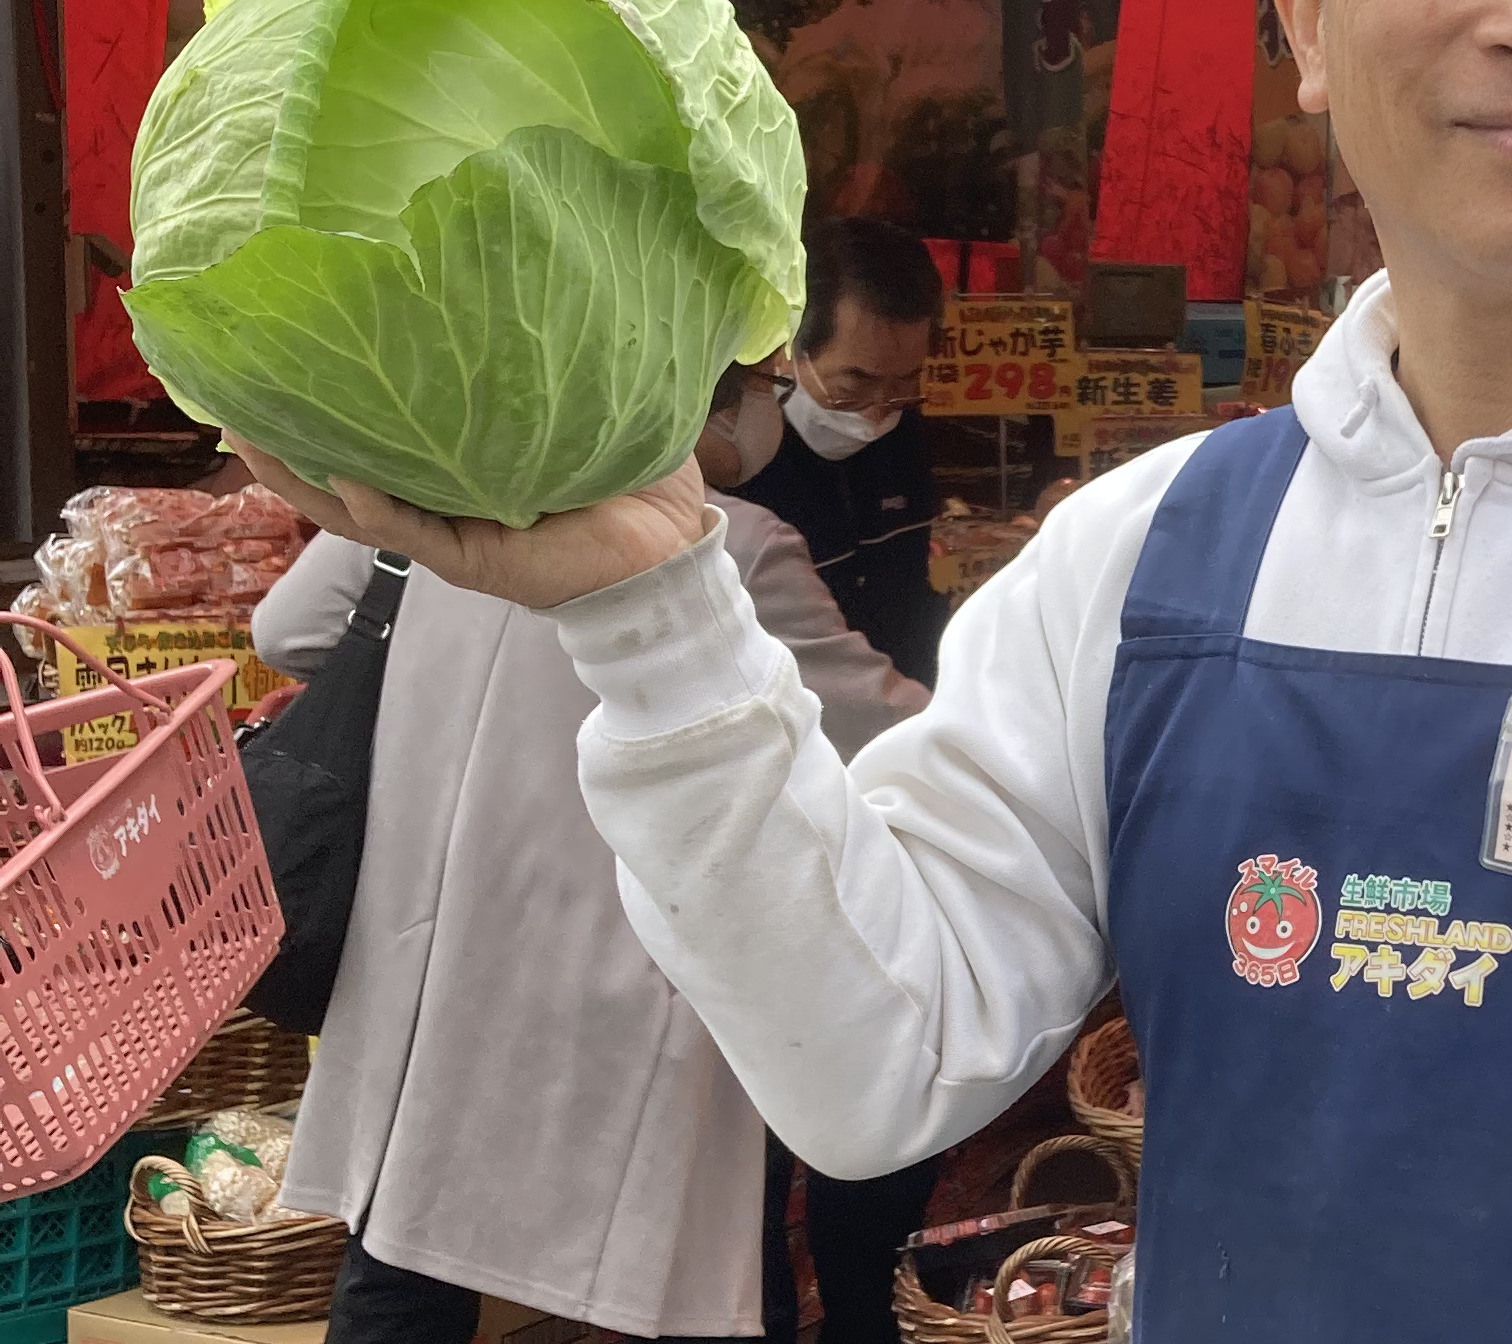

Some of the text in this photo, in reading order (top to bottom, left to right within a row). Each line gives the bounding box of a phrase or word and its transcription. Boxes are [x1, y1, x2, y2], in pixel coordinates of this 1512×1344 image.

[1237, 853, 1318, 891] スマイル
[1339, 873, 1453, 916] 生鮮市場
[1232, 952, 1301, 988] 365日
[1330, 941, 1500, 1008] アキダイ
